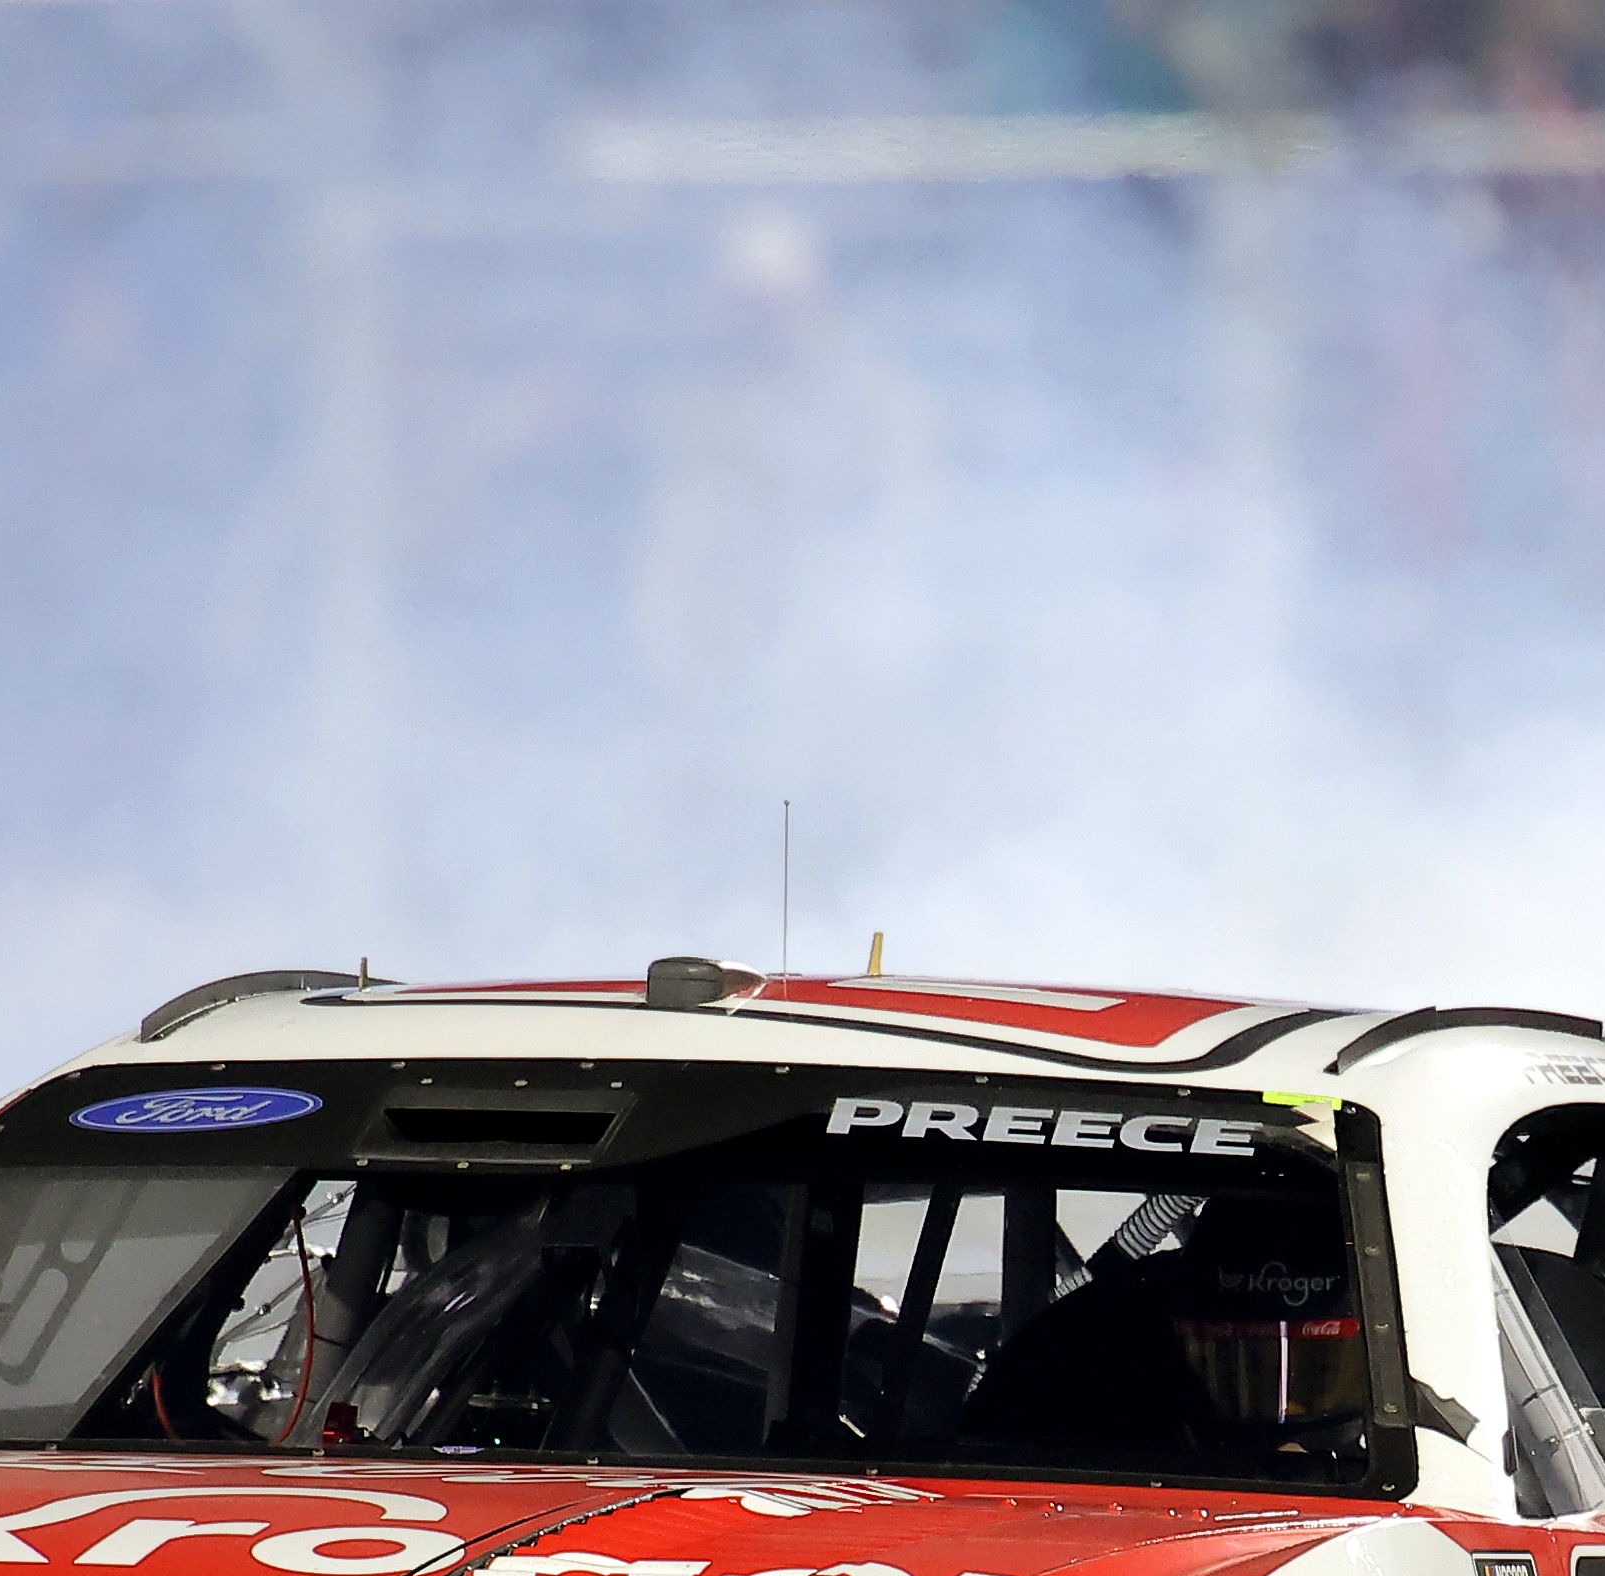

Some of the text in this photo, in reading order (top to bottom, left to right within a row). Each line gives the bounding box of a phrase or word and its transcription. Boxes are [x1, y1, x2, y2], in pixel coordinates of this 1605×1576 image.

[114, 1092, 273, 1128] Ford
[824, 1096, 1263, 1157] PREECE
[1249, 1260, 1338, 1307] Kroger
